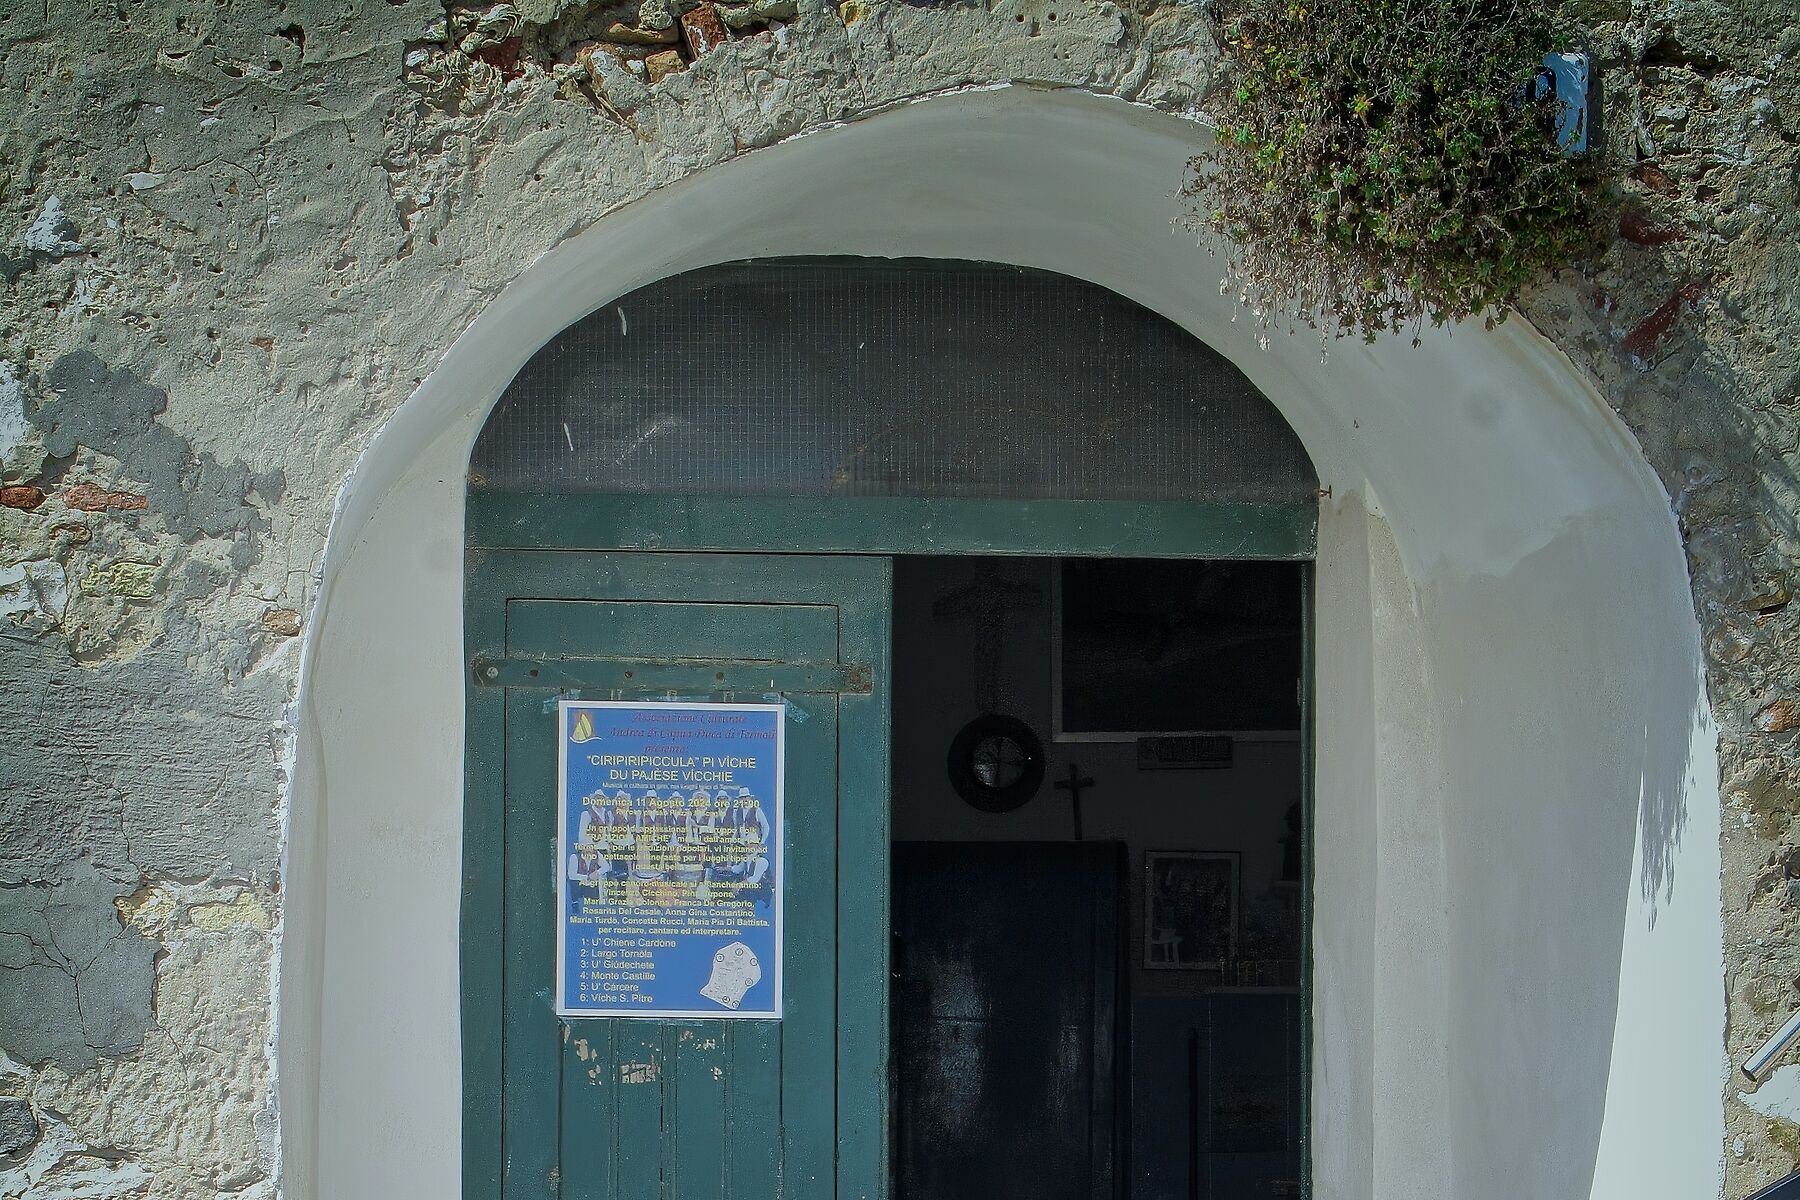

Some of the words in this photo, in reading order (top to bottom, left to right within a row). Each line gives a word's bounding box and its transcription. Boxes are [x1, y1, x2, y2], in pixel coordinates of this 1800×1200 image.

[703, 756, 715, 768] PI
[610, 769, 628, 780] DU
[582, 796, 633, 806] Domenica
[636, 797, 647, 806] 11
[650, 798, 685, 809] Agosto
[666, 908, 687, 916] Anna
[570, 916, 593, 924] Maria
[687, 918, 710, 926] Maria
[598, 927, 611, 935] per
[591, 948, 618, 960] Largo
[591, 970, 620, 981] Monte
[580, 993, 589, 1003] 6:
[619, 993, 630, 1003] S.
